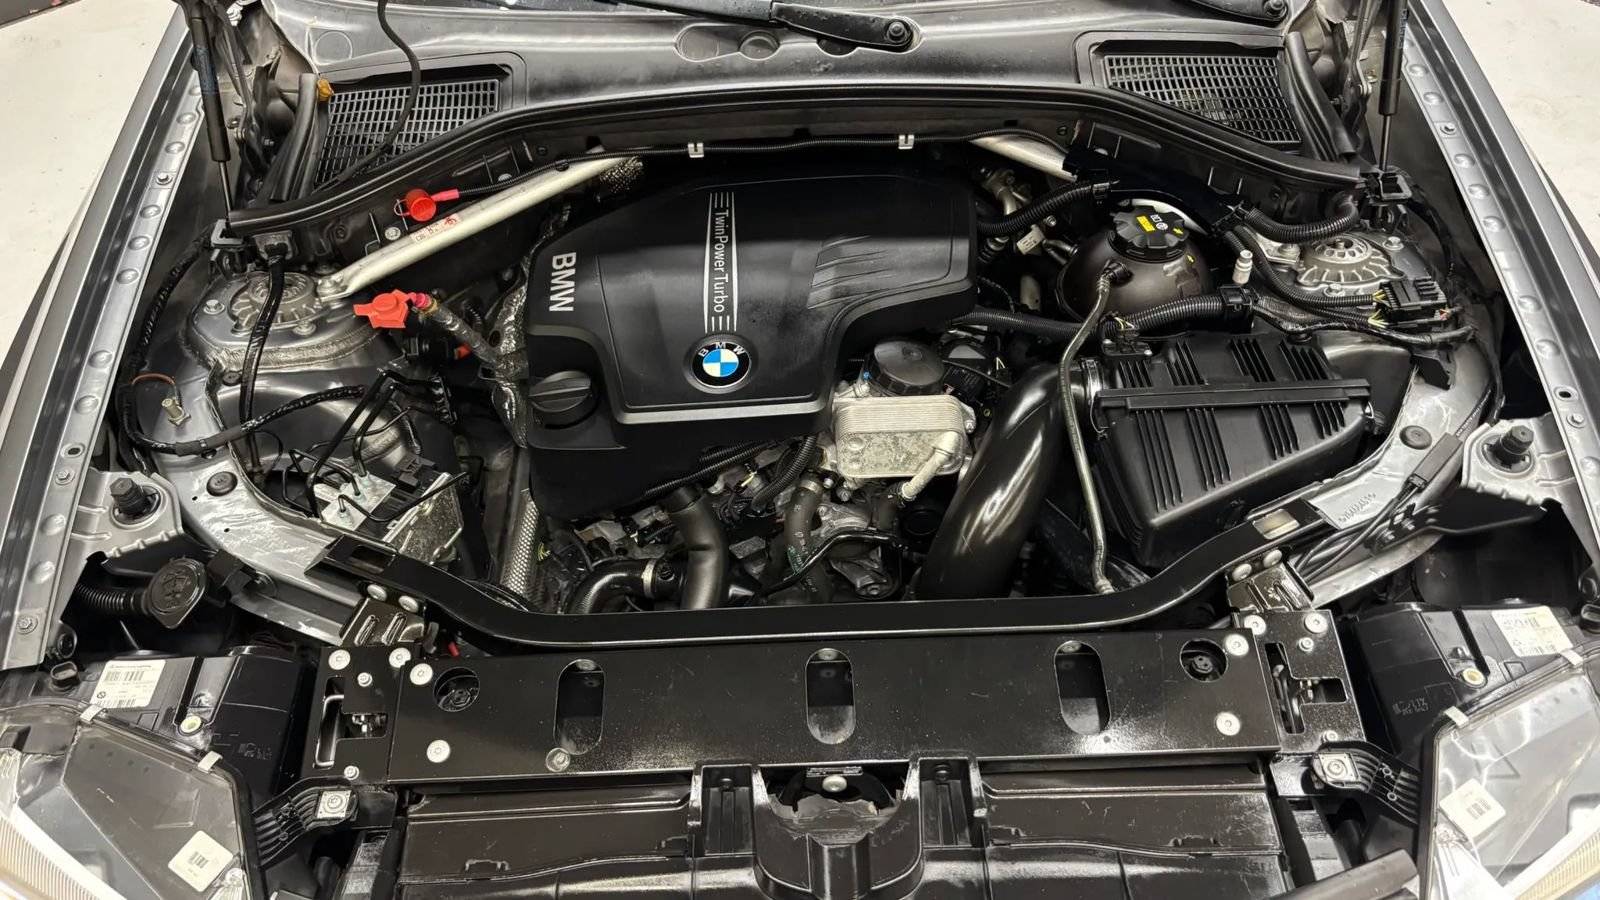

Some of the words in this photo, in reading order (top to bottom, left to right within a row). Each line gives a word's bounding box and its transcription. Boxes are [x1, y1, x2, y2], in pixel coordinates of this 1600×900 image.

[714, 209, 729, 272] TwinPower
[549, 252, 577, 312] BMW
[713, 273, 729, 313] Turbo
[697, 341, 746, 357] BMW
